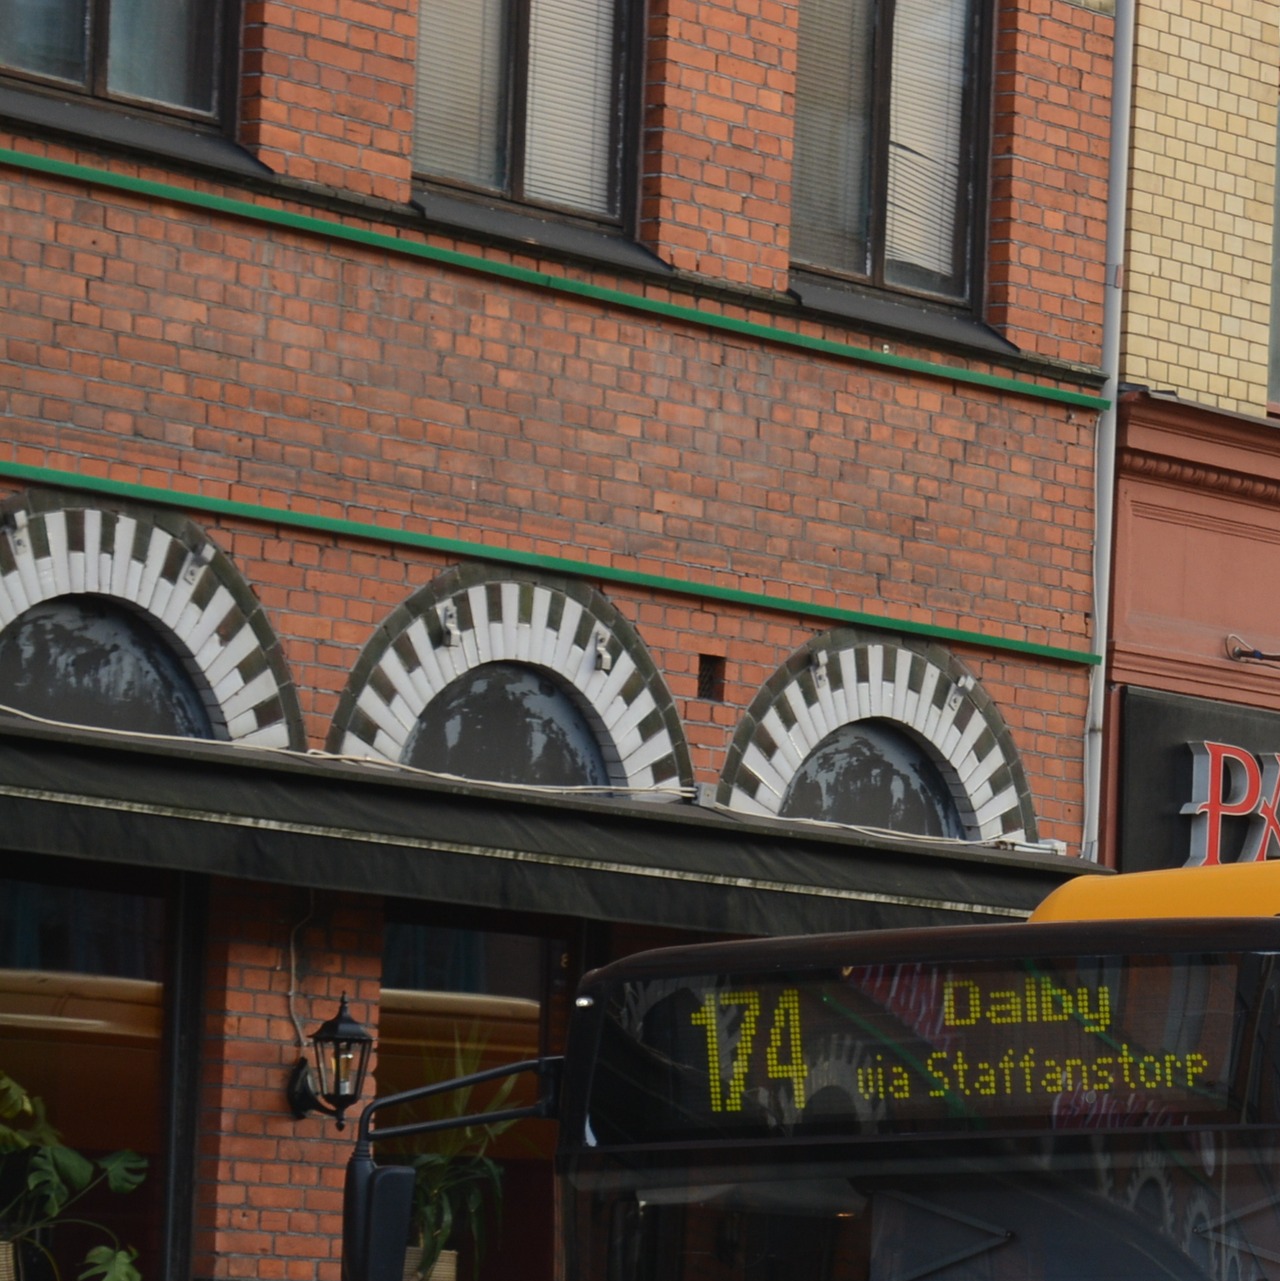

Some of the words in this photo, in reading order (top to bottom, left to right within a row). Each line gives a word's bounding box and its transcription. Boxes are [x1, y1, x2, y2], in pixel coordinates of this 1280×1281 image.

[944, 976, 1111, 1032] Dalby
[691, 989, 807, 1112] 174
[857, 1055, 910, 1100] via
[927, 1043, 1208, 1097] Staffanstorp
